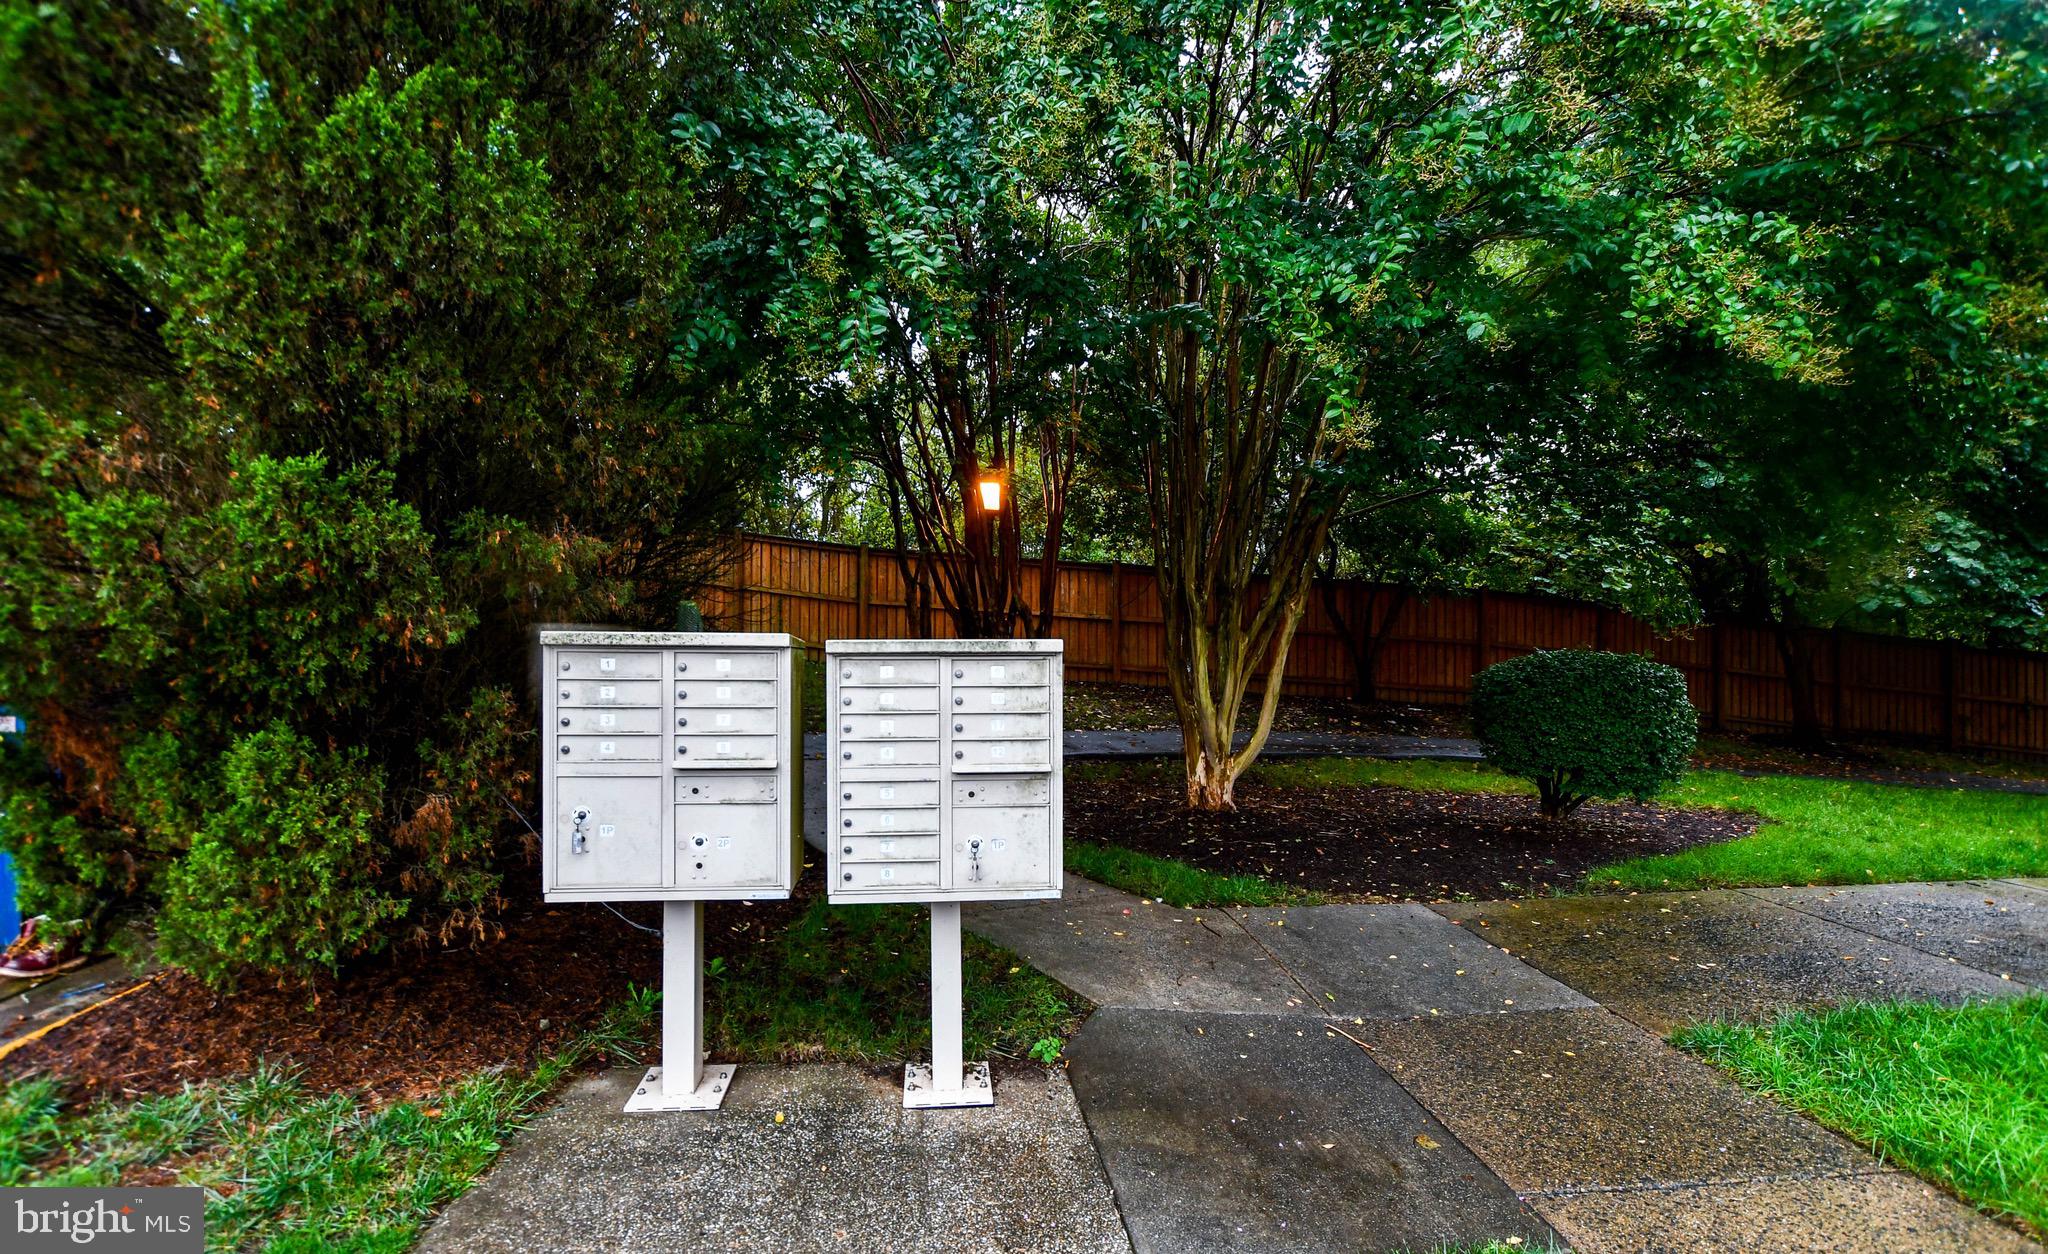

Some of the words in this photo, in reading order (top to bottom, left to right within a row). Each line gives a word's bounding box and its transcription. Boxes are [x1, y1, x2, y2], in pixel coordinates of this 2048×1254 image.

[605, 688, 611, 697] 2
[604, 743, 611, 751] 4
[602, 826, 614, 834] 1P
[718, 839, 730, 848] 2P
[993, 840, 1005, 848] 1P
[884, 869, 890, 878] 8
